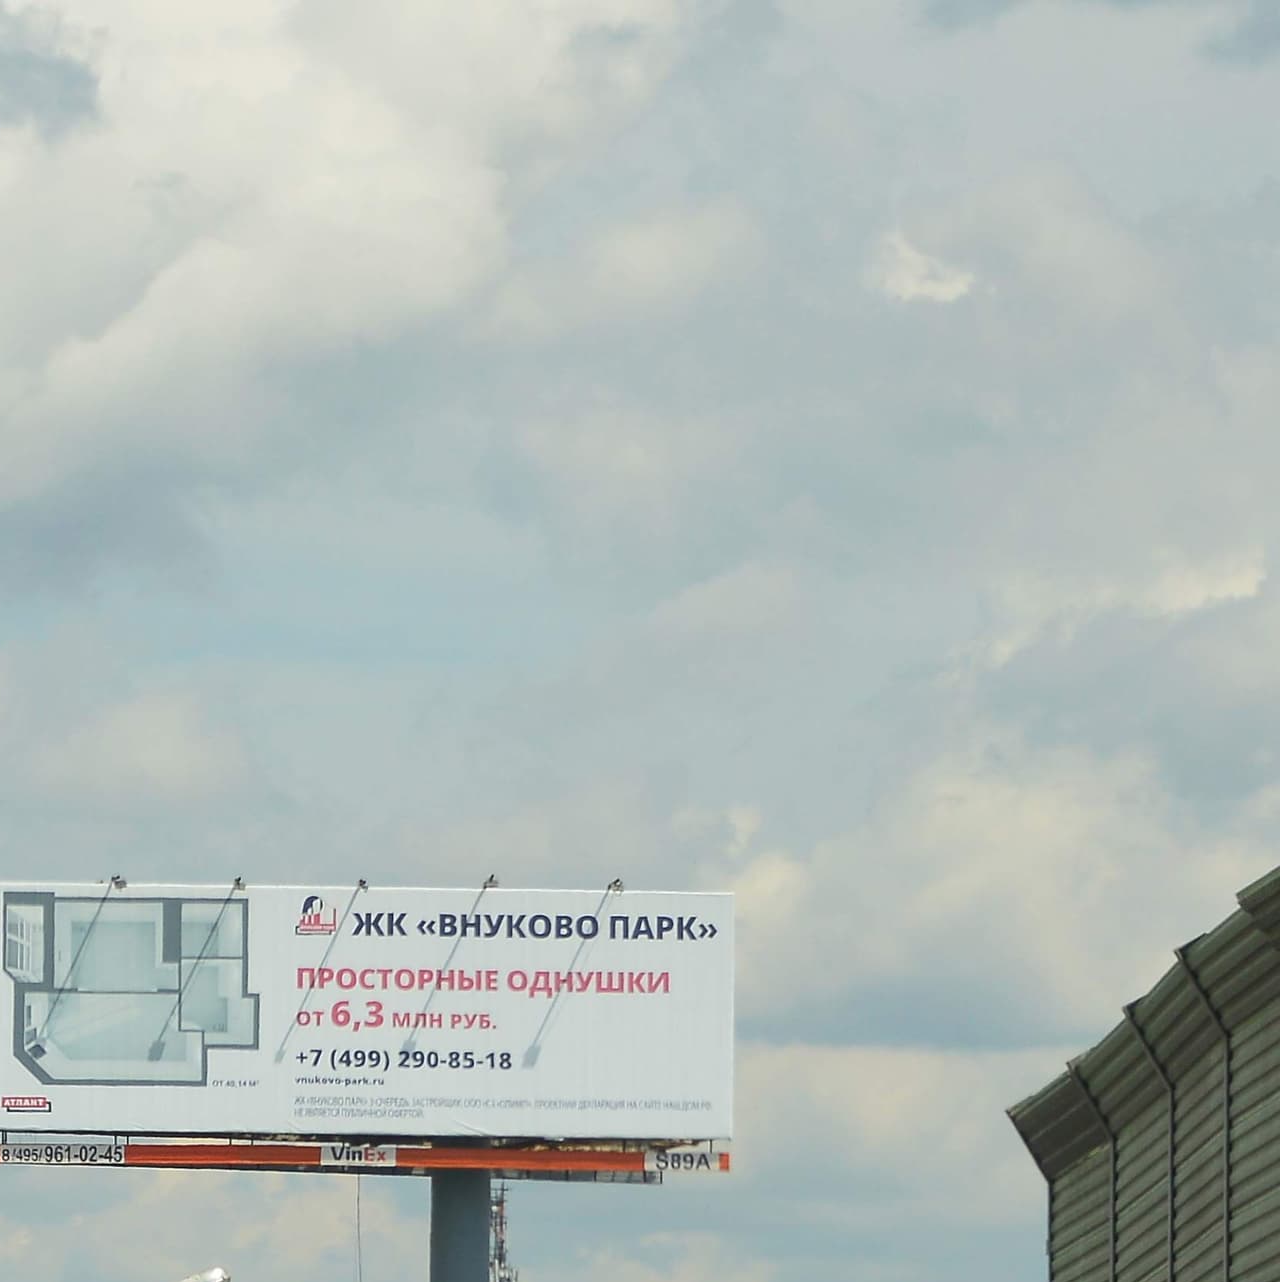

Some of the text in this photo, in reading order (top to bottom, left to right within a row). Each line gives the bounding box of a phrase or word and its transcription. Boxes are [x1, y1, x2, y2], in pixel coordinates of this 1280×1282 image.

[352, 912, 718, 941] ЖК «ВНУКОВО ПАРК»
[296, 968, 671, 998] ПРОСТОРНЫЕ ОДНУШКИ
[296, 1000, 498, 1032] ОТ 6,3 МЛН РУБ.
[295, 1048, 513, 1071] +7 (499) 290-85-18
[295, 1075, 385, 1087] vnukovo-park.ru
[3, 1099, 45, 1107] АТЛАНТ
[330, 1145, 386, 1162] VinEx
[655, 1152, 711, 1171] S89A
